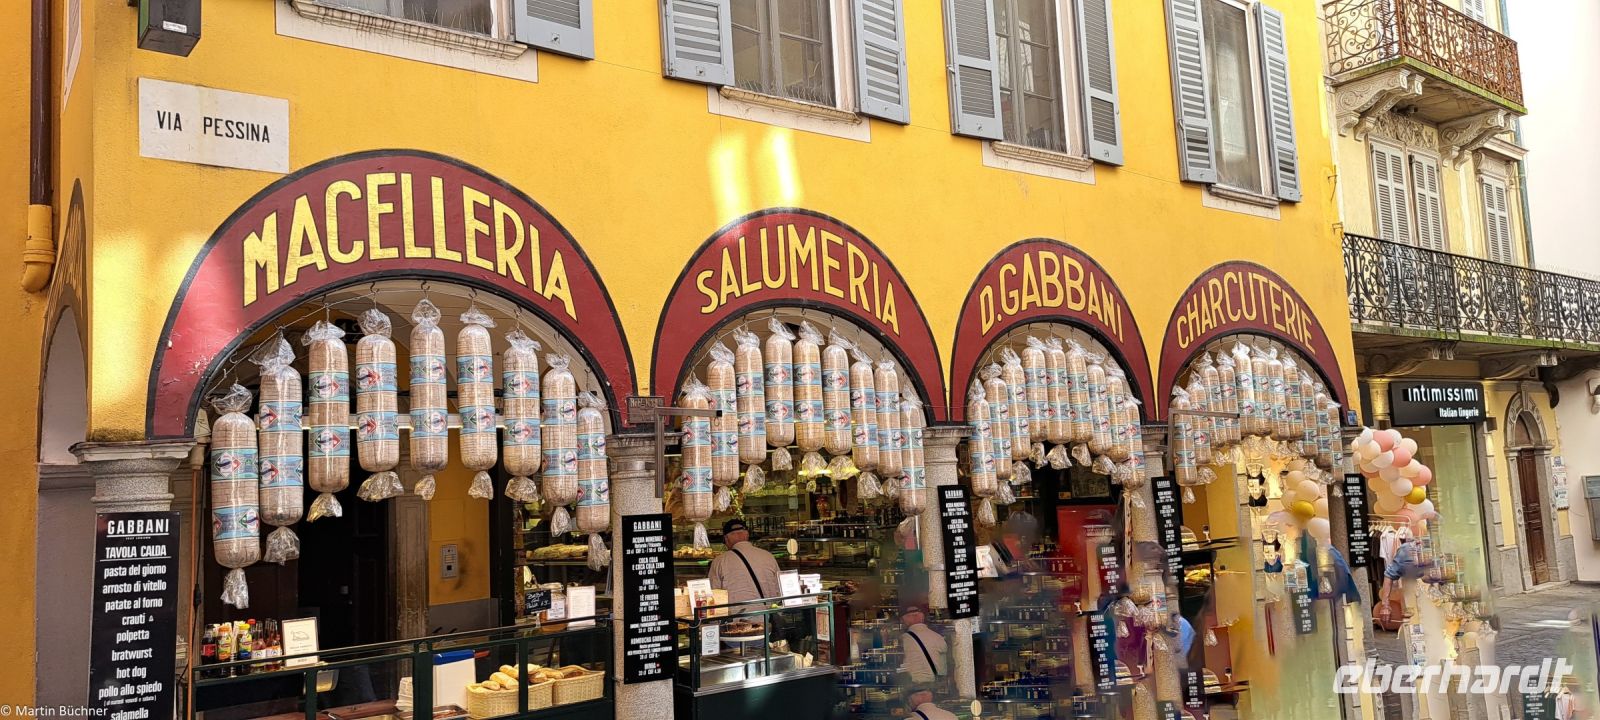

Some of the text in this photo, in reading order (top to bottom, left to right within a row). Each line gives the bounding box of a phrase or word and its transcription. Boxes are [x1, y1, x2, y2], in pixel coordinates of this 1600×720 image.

[156, 110, 270, 144] VIA PESSINA
[242, 172, 578, 322] MACELLERIA
[696, 223, 901, 336] SALUMERIA
[1176, 270, 1316, 355] CHARCUTERIE
[1408, 384, 1478, 402] intimissimi
[1439, 406, 1479, 419] Italian lingerie
[107, 518, 169, 534] GABBANI
[633, 520, 662, 530] GABBANI
[106, 545, 166, 559] TAVOLA CALDA
[104, 564, 166, 579] pasta del giorno
[102, 580, 166, 594] arrosto di vitello
[105, 597, 163, 612] patate al forno
[122, 613, 146, 625] crauti
[116, 630, 150, 644] polpetta
[112, 648, 152, 661] bratwurst
[116, 666, 146, 679] hot dog
[99, 681, 162, 700] pollo allo spiedo
[111, 707, 149, 720] salamella
